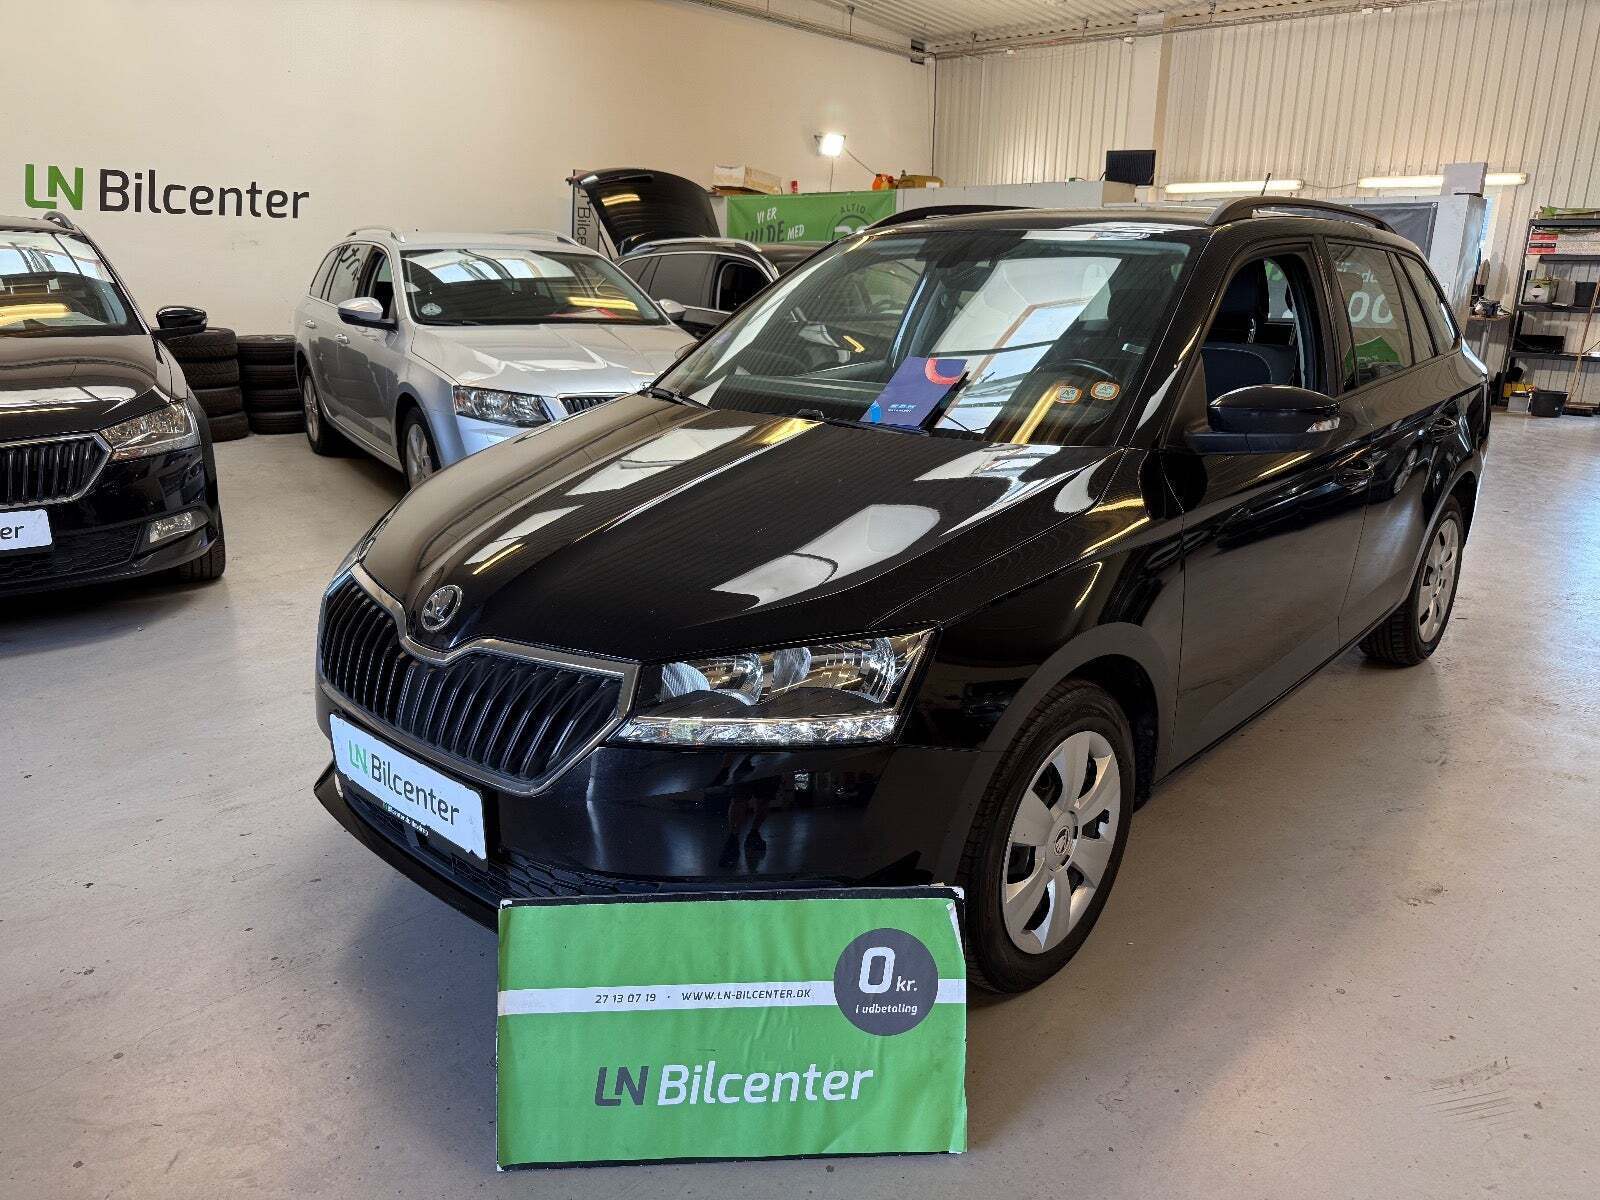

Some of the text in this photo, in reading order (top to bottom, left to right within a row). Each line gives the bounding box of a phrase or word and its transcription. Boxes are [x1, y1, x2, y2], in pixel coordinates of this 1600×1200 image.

[25, 163, 309, 218] LN Bilcenter
[756, 207, 777, 224] VI ER
[787, 224, 804, 240] MED
[348, 740, 368, 774] LN
[371, 753, 460, 825] Bilcenter
[858, 946, 918, 993] 0 kr.
[595, 989, 811, 1004] 27 13 07 19 WWW.LN-BILCENTER.DK
[862, 1003, 918, 1015] udbetaling
[594, 1061, 874, 1106] LN Bilcenter
